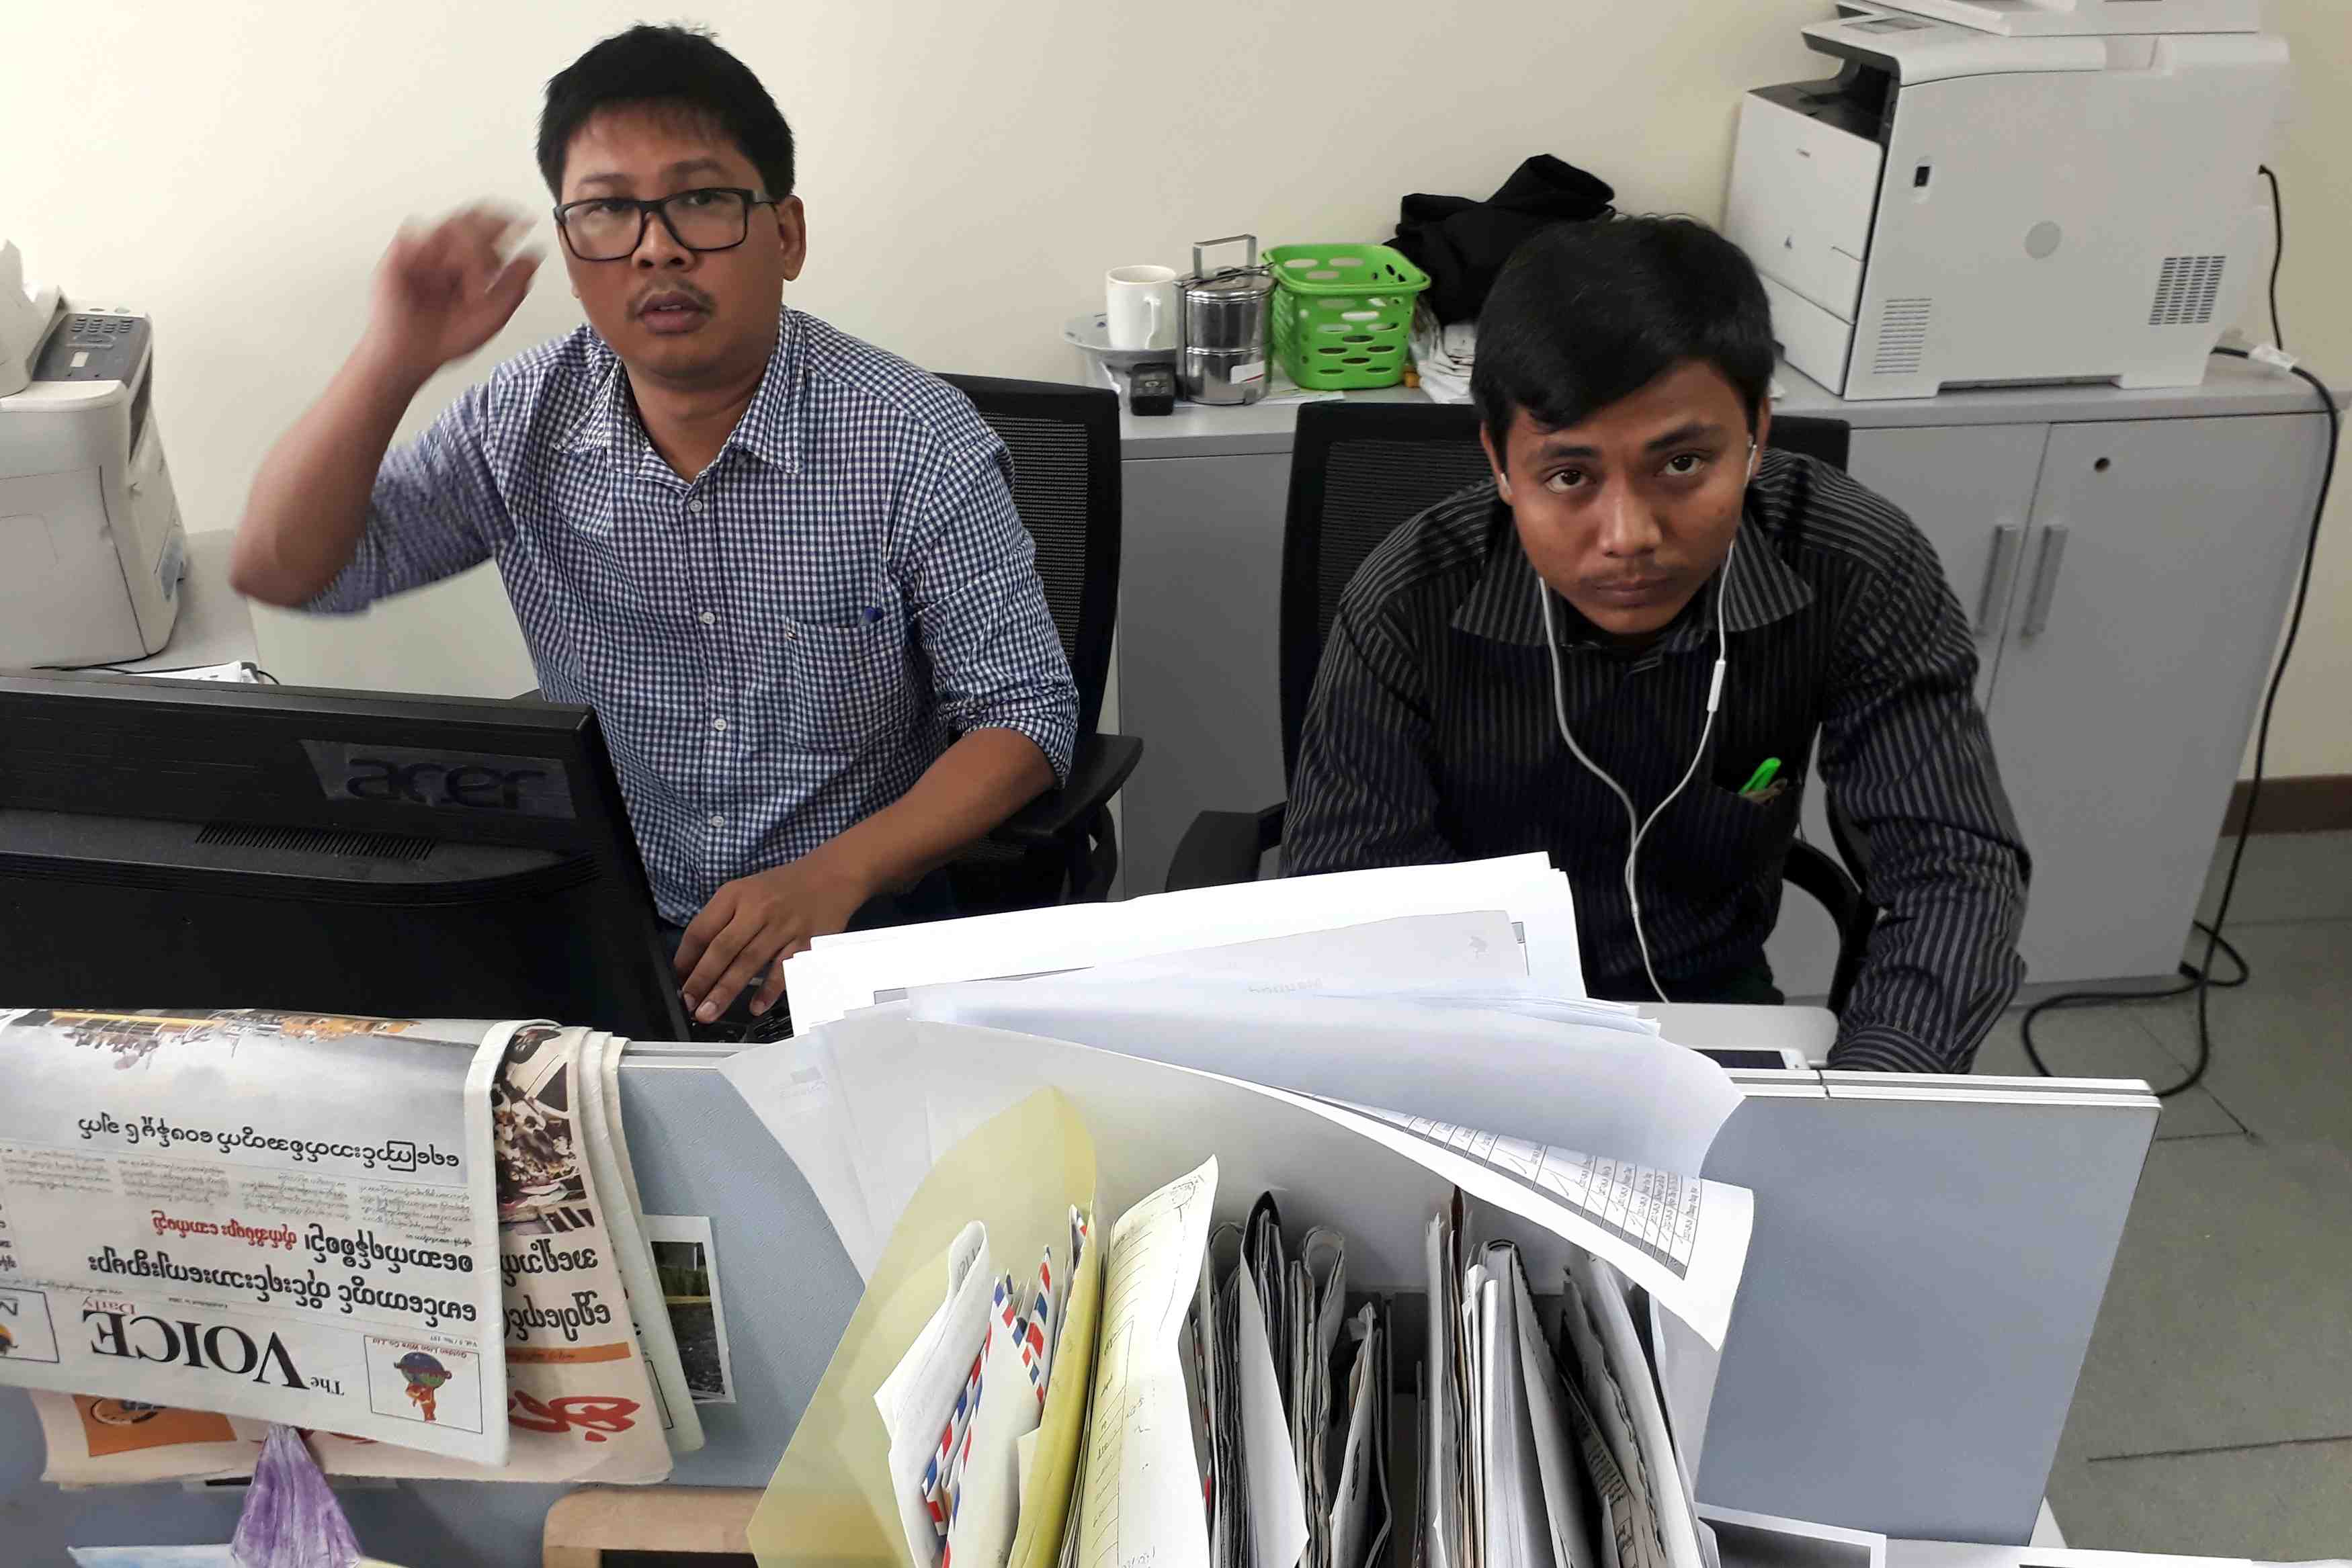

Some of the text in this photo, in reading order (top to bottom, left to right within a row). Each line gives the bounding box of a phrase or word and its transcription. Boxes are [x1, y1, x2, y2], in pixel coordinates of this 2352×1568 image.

[346, 758, 548, 810] acer
[77, 1112, 120, 1140] ချက်
[81, 1296, 136, 1316] Daily
[82, 1309, 345, 1397] The VOICE
